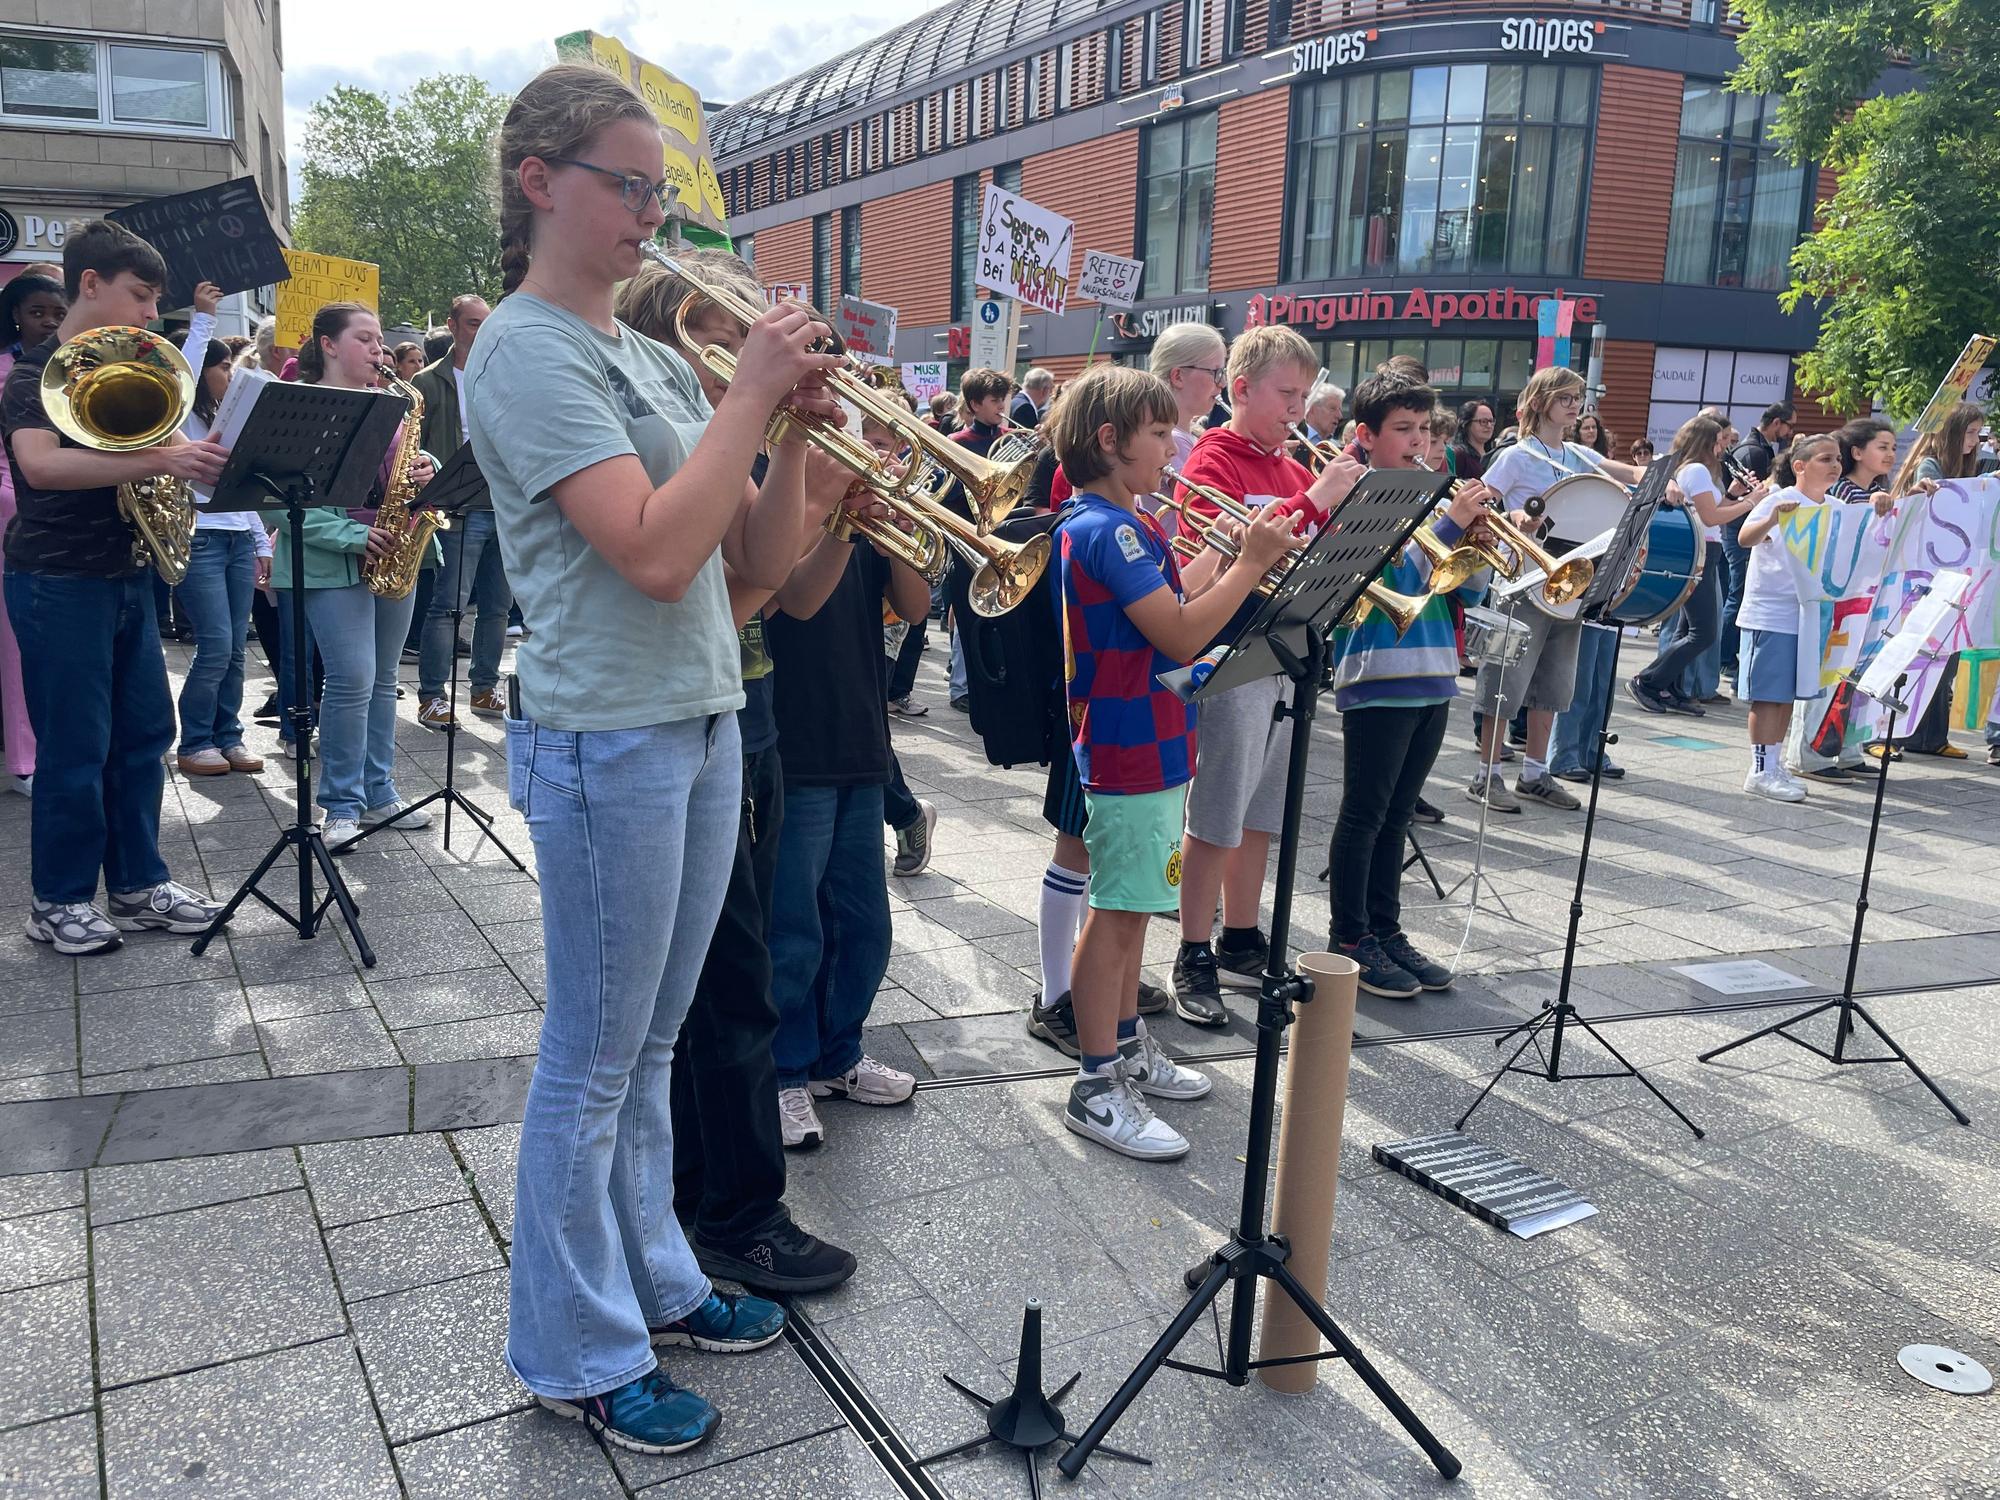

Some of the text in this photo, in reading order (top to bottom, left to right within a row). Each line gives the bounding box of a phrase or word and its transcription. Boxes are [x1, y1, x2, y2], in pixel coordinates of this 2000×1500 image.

[1292, 30, 1366, 75] snipes
[1501, 18, 1594, 58] snipes
[664, 162, 694, 188] apelle
[24, 215, 65, 247] Pe
[344, 264, 367, 283] UNS
[1089, 256, 1140, 281] RETTET
[279, 295, 320, 314] MUSI
[1270, 287, 1393, 330] Pinguin
[948, 325, 971, 358] RE
[913, 364, 941, 375] MUSIK
